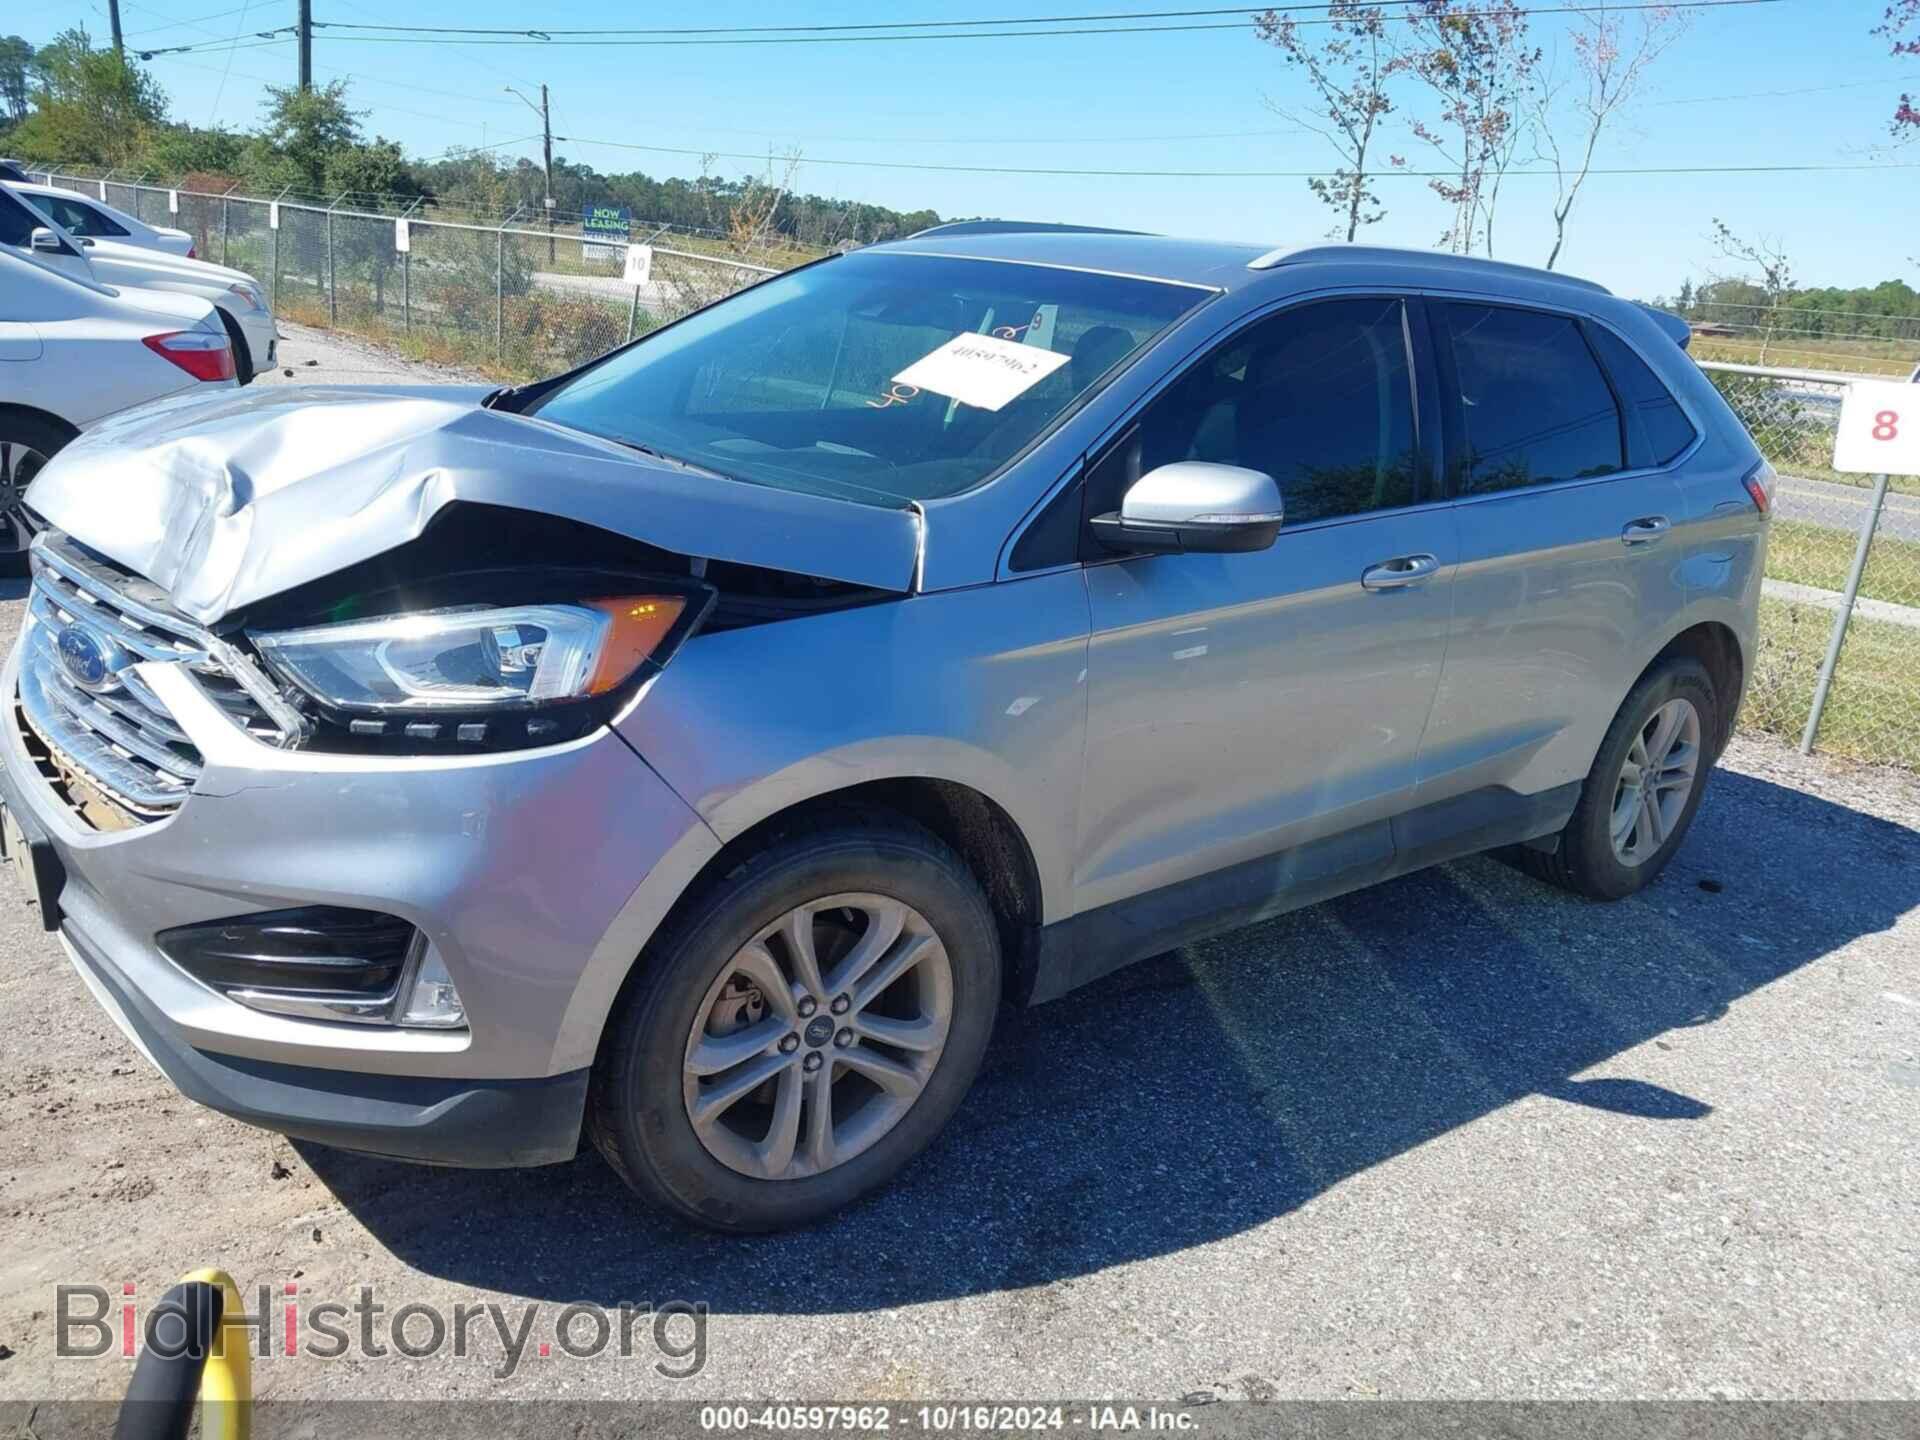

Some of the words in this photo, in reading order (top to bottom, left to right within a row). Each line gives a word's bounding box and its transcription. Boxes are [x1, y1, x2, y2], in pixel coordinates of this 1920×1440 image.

[594, 208, 619, 219] NOW
[585, 219, 628, 230] LEASING
[632, 257, 646, 271] 10
[1871, 410, 1899, 441] 8
